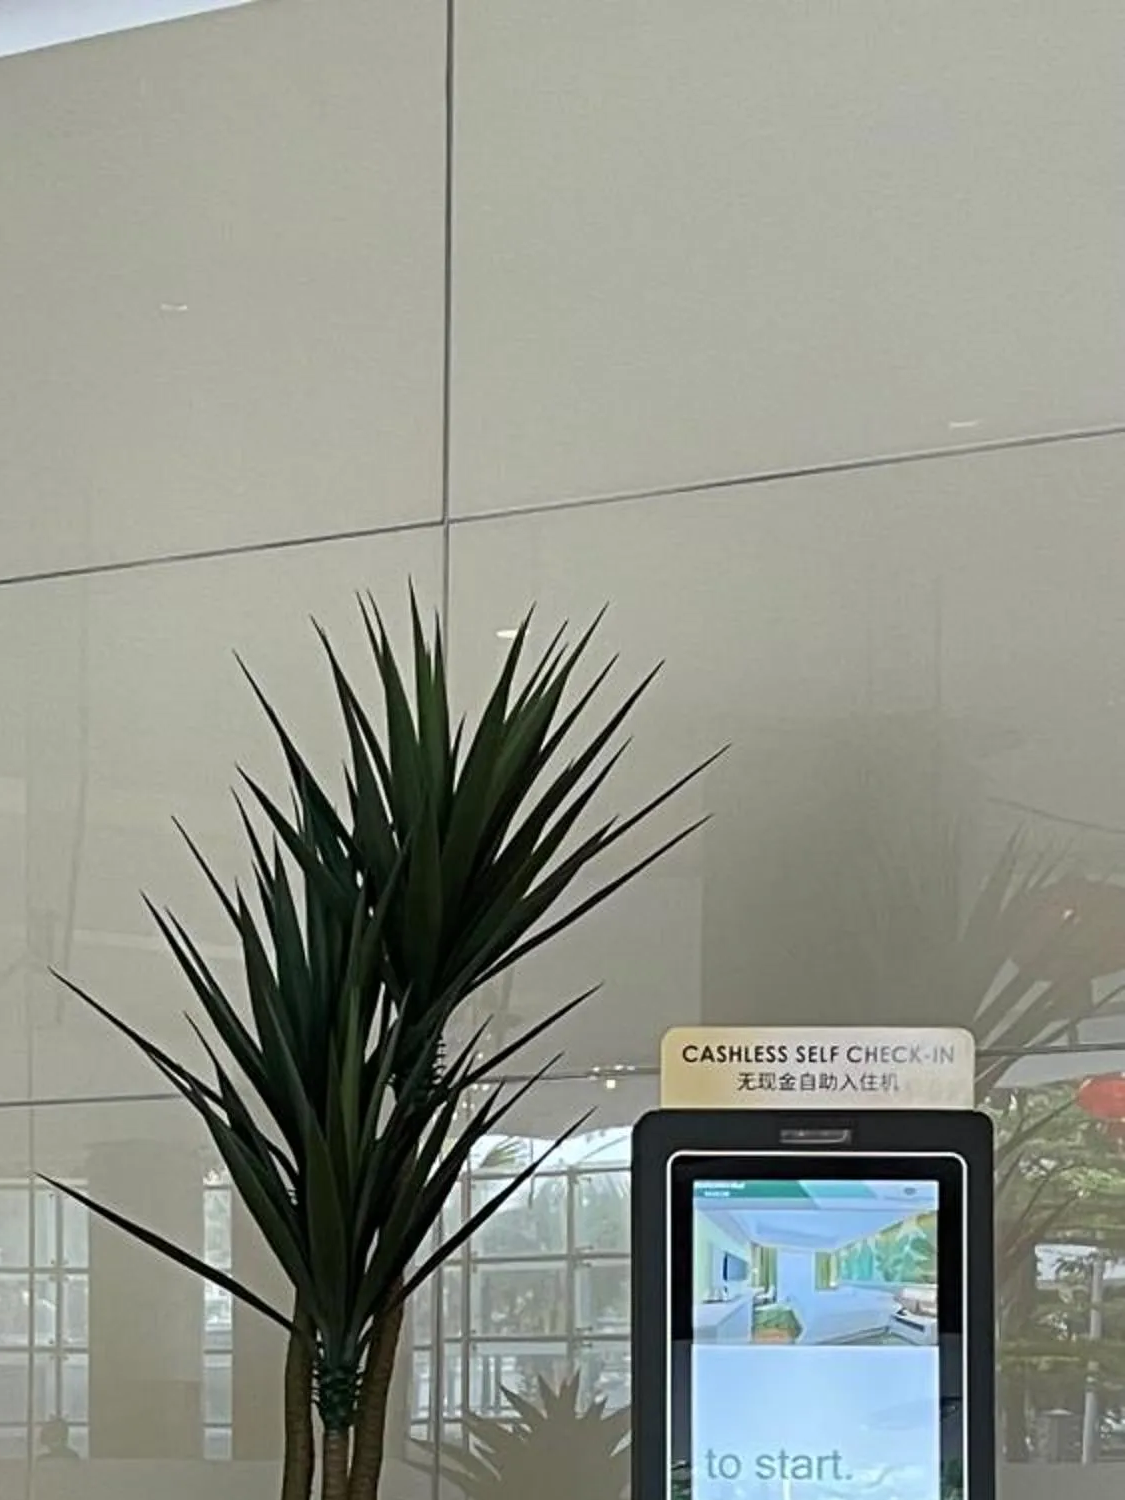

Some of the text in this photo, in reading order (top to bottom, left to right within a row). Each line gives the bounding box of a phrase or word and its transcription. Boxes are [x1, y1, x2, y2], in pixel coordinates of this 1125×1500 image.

[682, 1045, 955, 1064] CASHLESS SELF CHECK-IN
[736, 1071, 900, 1093] 无现金自助入住机
[705, 1448, 854, 1481] to start.
